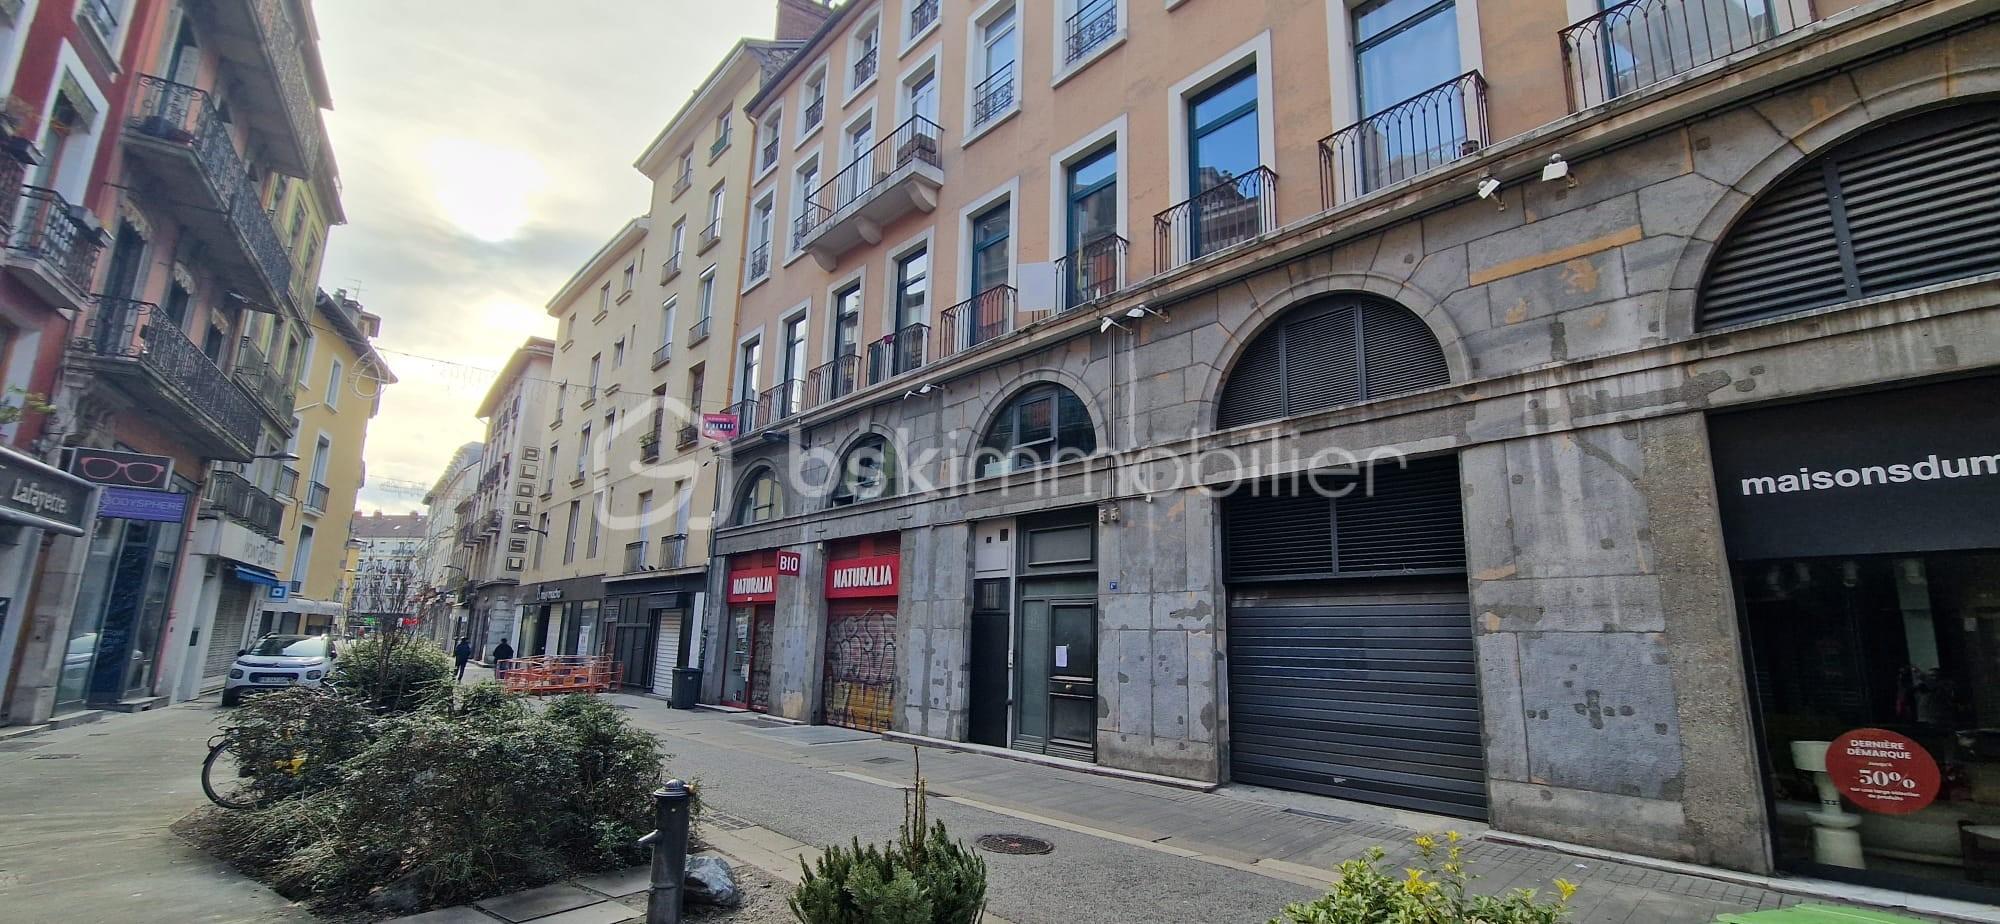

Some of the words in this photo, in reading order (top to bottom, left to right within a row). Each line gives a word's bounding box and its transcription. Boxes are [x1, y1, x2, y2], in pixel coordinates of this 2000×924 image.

[1741, 453, 2000, 496] maisonsdum
[11, 478, 66, 513] Lafayette
[103, 495, 185, 511] BODYSPHERE
[779, 555, 799, 572] BIO
[732, 575, 773, 595] NATURALIA
[833, 564, 893, 589] NATURALIA
[1847, 748, 1912, 759] DÉMARQUE
[1850, 740, 1904, 750] DERNIÈRE
